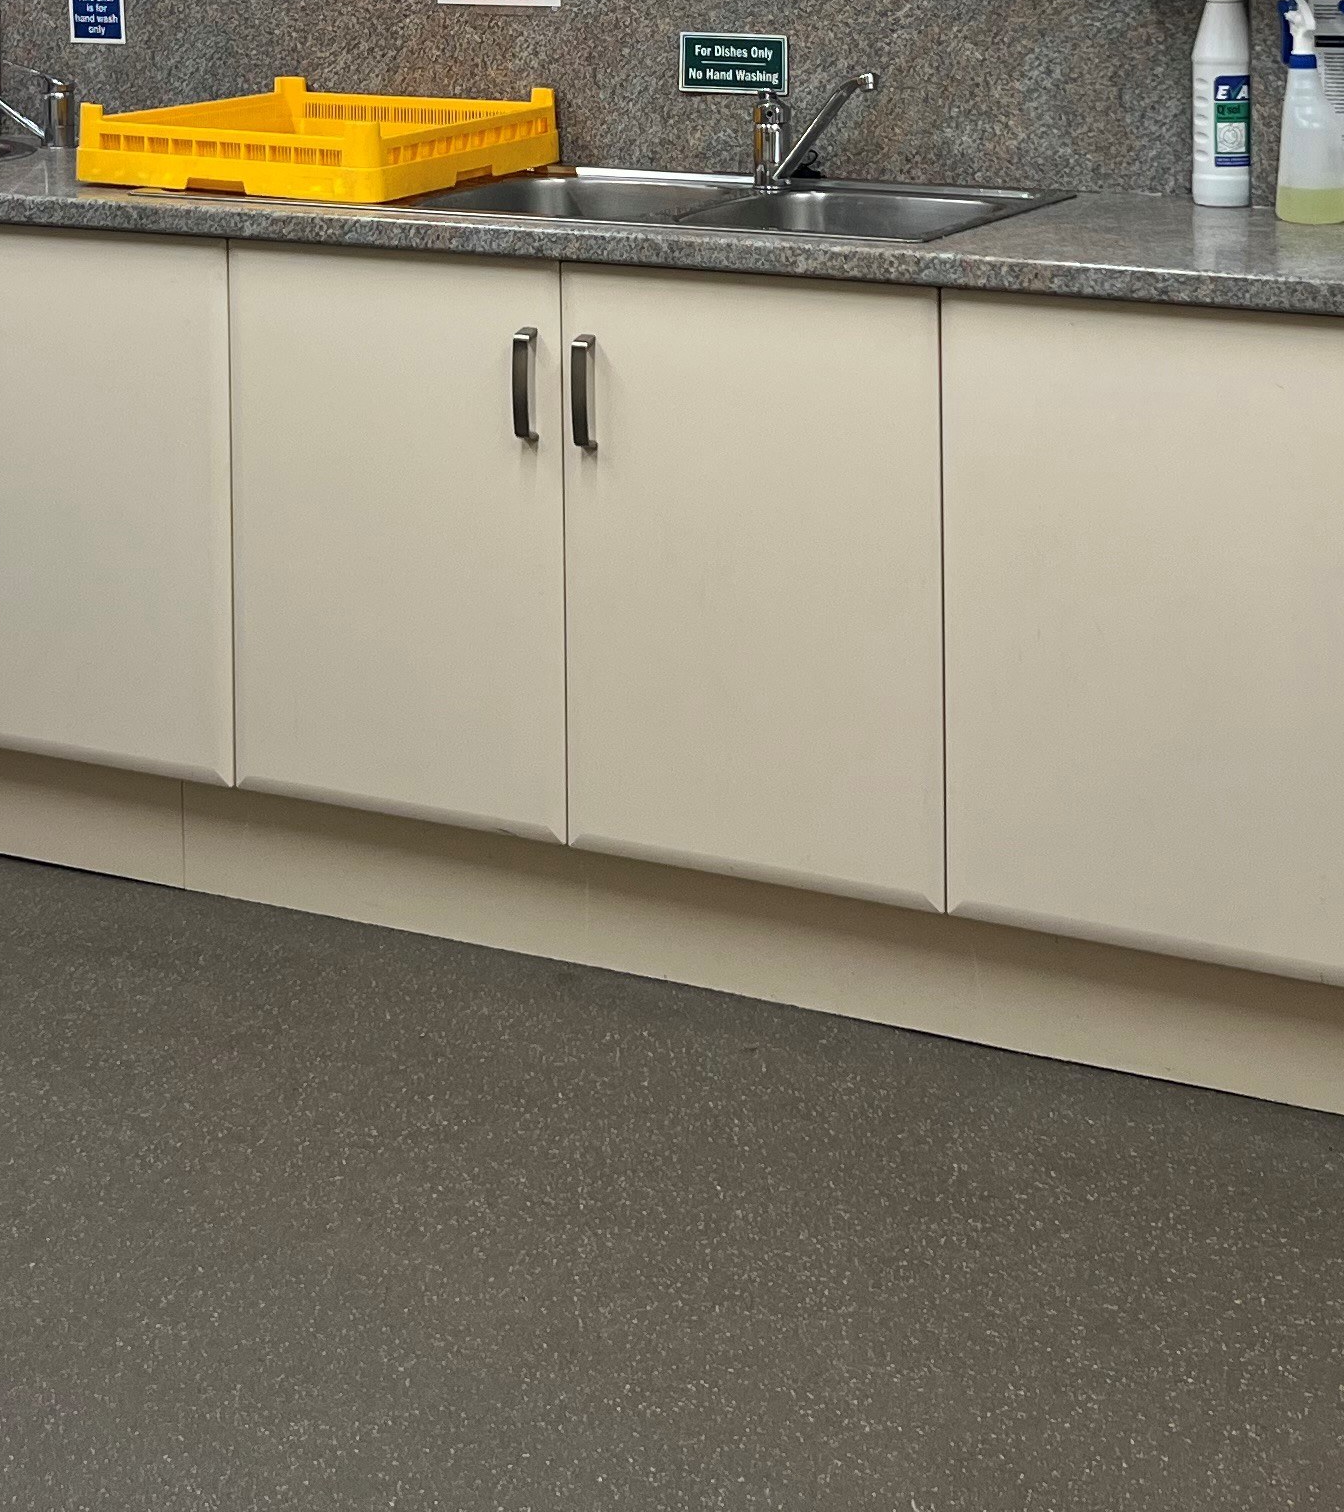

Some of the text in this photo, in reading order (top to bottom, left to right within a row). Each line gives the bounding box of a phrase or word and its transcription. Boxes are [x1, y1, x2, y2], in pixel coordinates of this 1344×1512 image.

[86, 3, 107, 13] is for
[74, 13, 119, 24] hand wash
[88, 24, 106, 36] only
[694, 44, 774, 61] For Dishes Only
[688, 67, 779, 85] No Hand Washing
